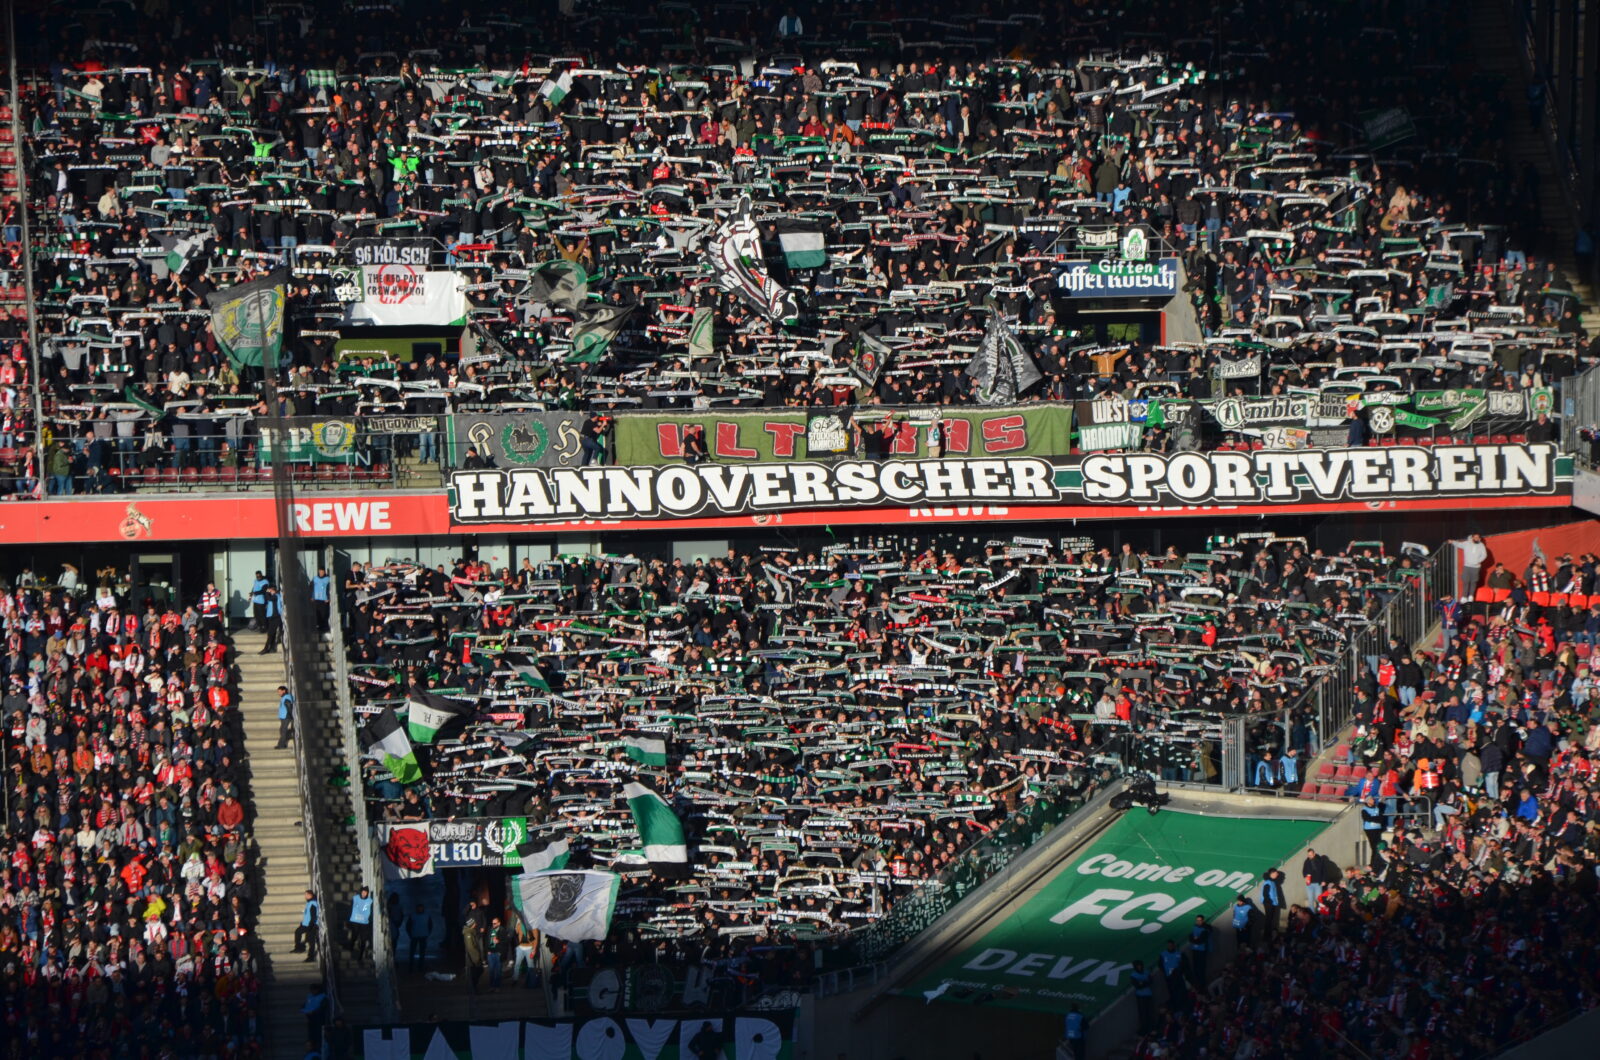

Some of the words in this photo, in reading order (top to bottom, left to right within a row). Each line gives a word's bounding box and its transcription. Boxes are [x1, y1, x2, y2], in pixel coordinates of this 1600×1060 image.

[355, 247, 371, 265] 96
[374, 240, 430, 265] KÖLSCH
[1098, 259, 1153, 274] Giften
[1092, 400, 1128, 424] WEST
[453, 459, 1054, 518] HANNOVERSCHER
[1083, 445, 1551, 498] SPORTVEREIN
[287, 502, 392, 531] REWE
[1077, 853, 1194, 884] Come
[1049, 888, 1206, 934] FC!
[961, 947, 1134, 986] DEVK
